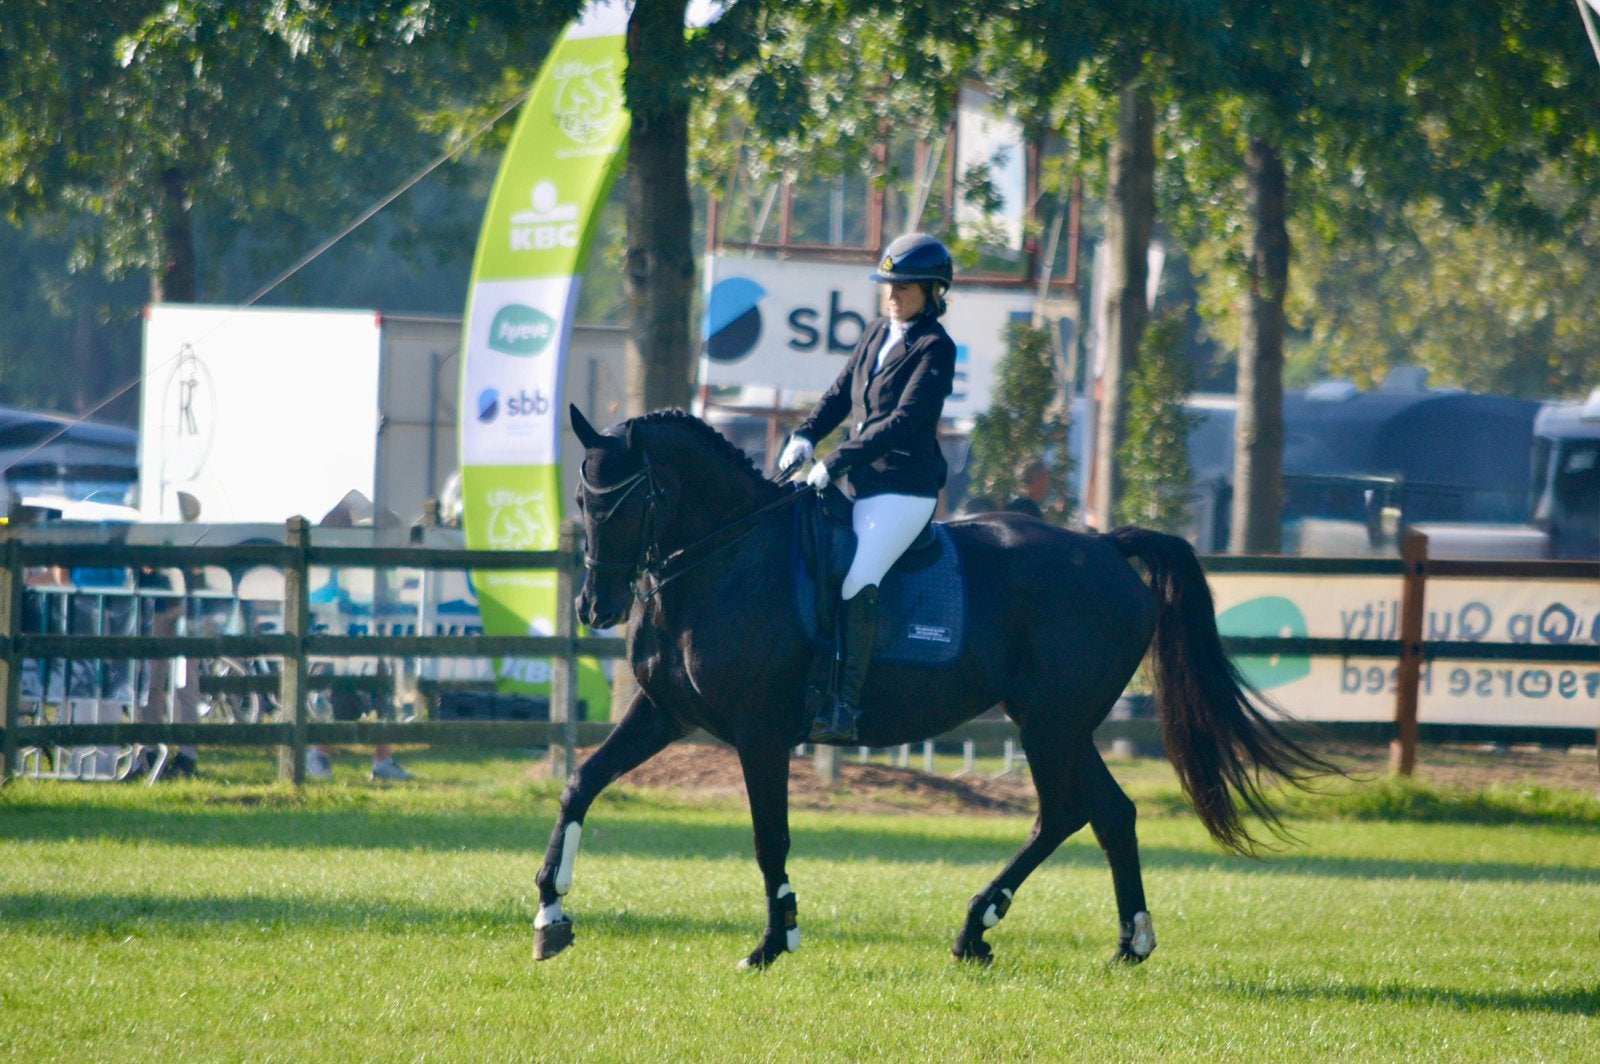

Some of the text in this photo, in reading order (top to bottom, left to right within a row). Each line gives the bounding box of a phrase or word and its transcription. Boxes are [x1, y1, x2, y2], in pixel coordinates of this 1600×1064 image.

[510, 223, 578, 252] KBC
[507, 389, 548, 416] sbb
[503, 656, 554, 683] KB
